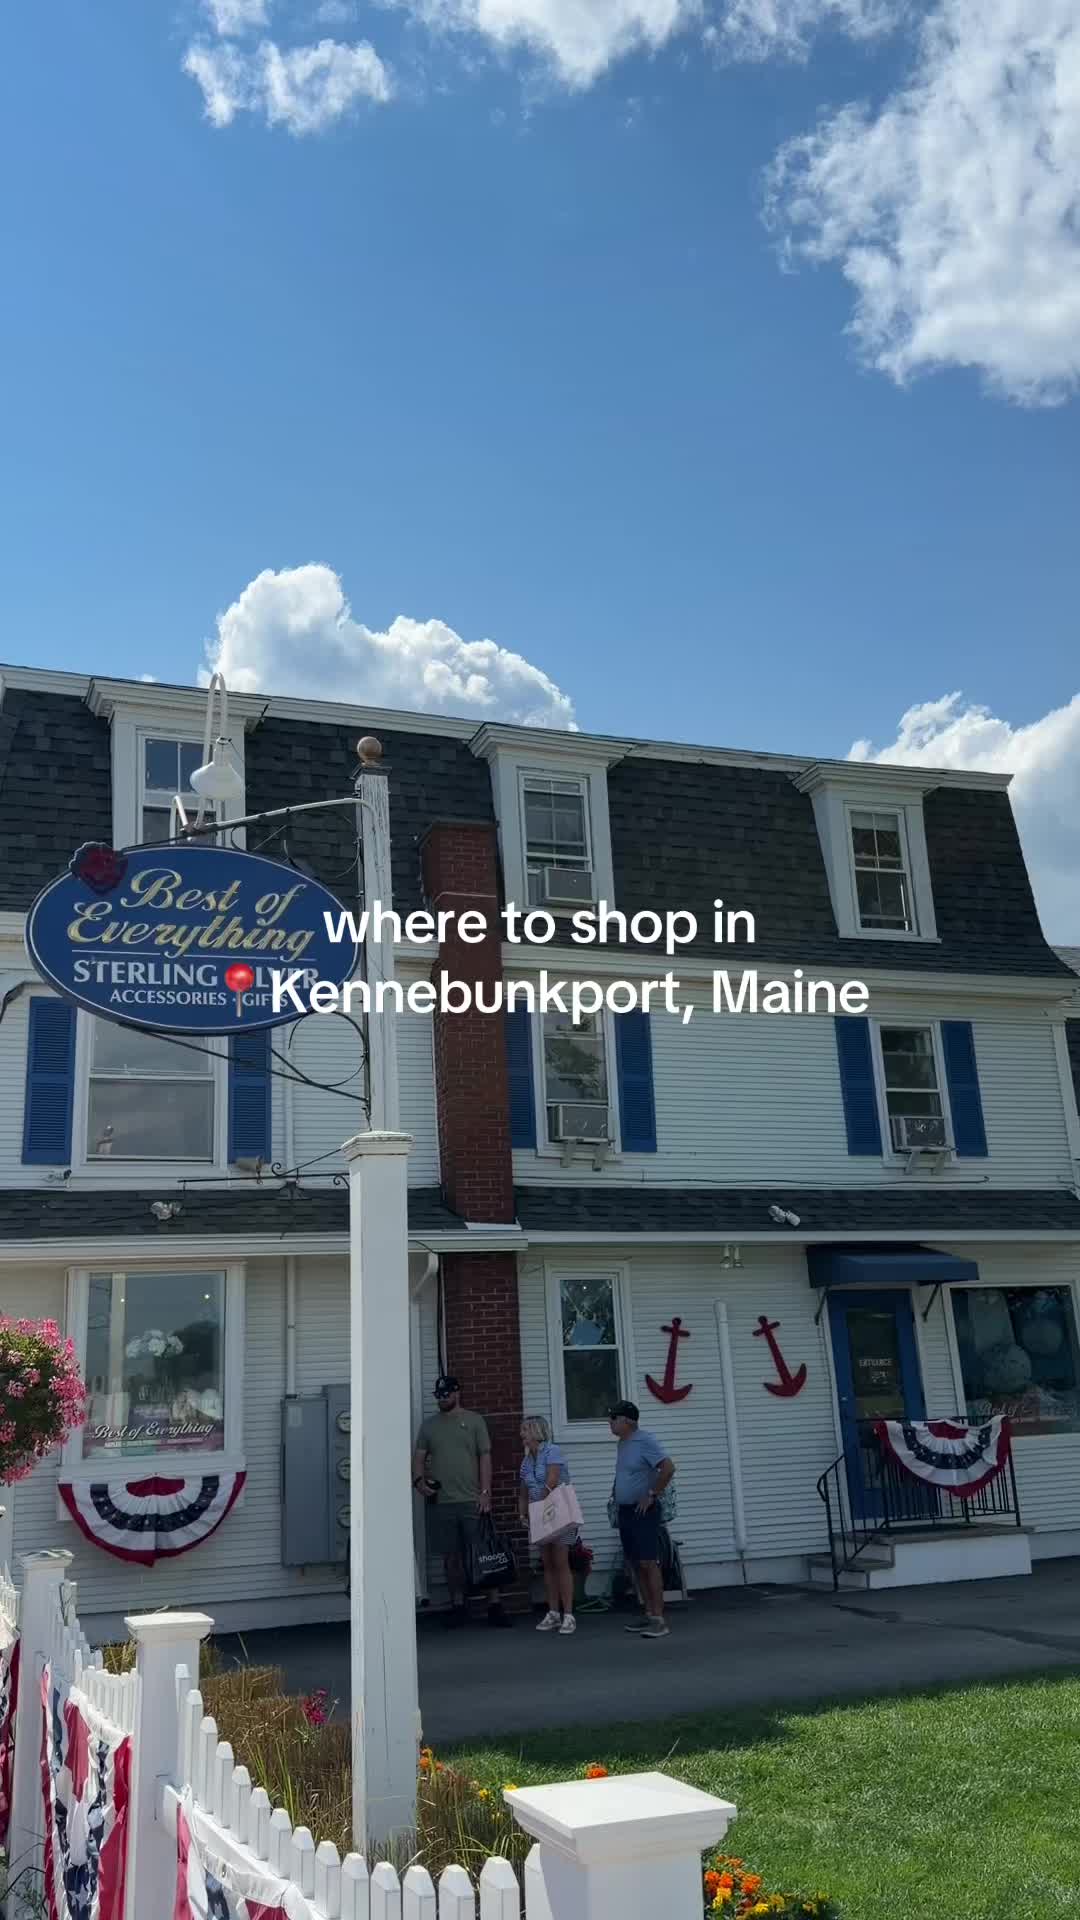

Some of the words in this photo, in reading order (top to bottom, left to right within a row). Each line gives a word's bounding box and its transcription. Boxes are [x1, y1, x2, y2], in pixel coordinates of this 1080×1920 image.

[120, 868, 242, 912] Best
[255, 883, 307, 926] of
[67, 901, 315, 962] Everything
[73, 959, 218, 987] STERLING
[228, 965, 319, 990] LVER
[110, 989, 227, 1006] ACCESSORIES
[95, 1424, 128, 1439] Best
[128, 1424, 145, 1440] of
